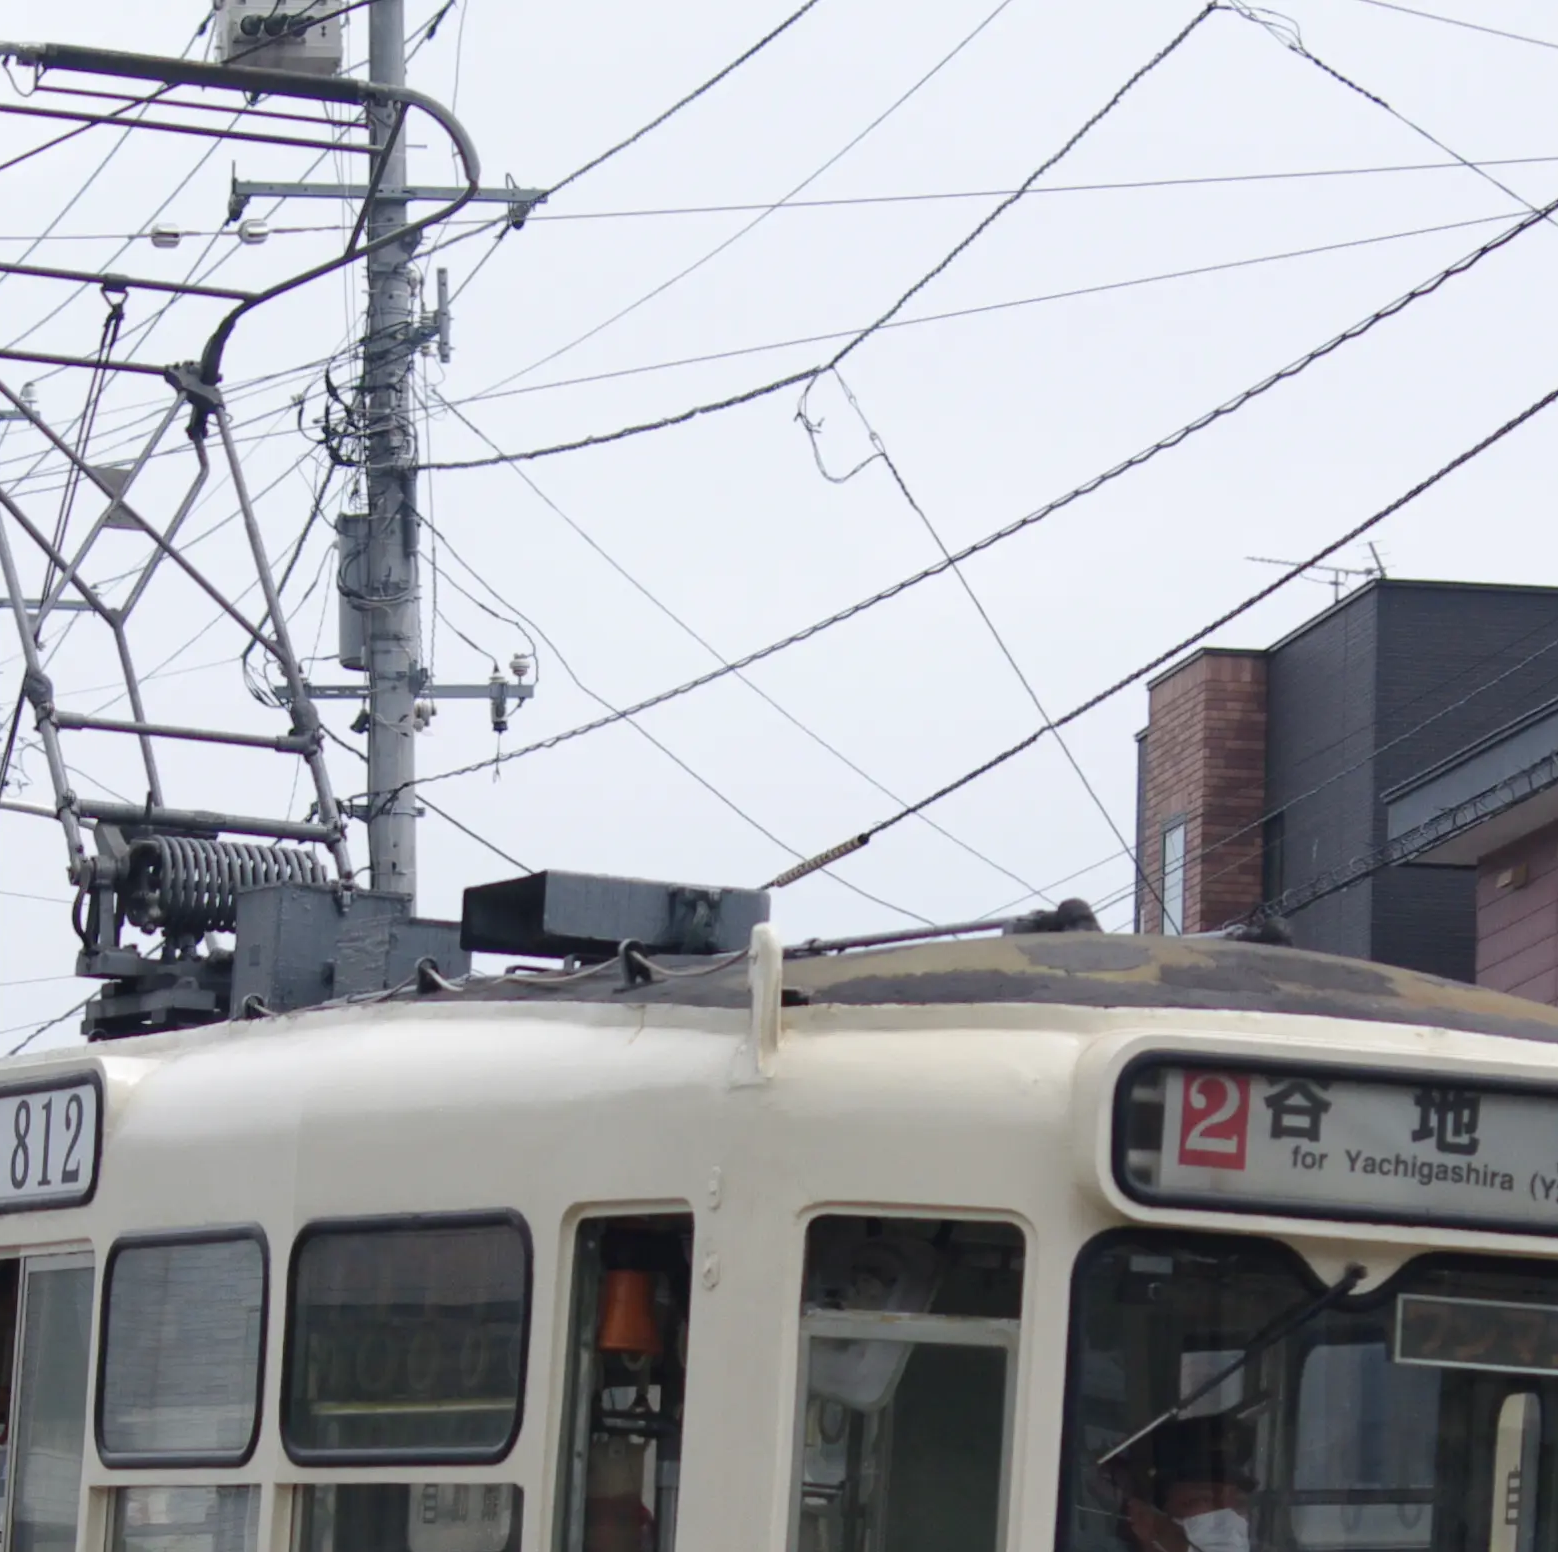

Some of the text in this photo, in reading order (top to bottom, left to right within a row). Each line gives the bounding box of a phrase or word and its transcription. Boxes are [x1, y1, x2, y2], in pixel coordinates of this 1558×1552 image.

[11, 1093, 83, 1190] 812
[1186, 1075, 1240, 1153] 2
[1292, 1146, 1329, 1171] for
[1345, 1148, 1515, 1192] Yachigashira
